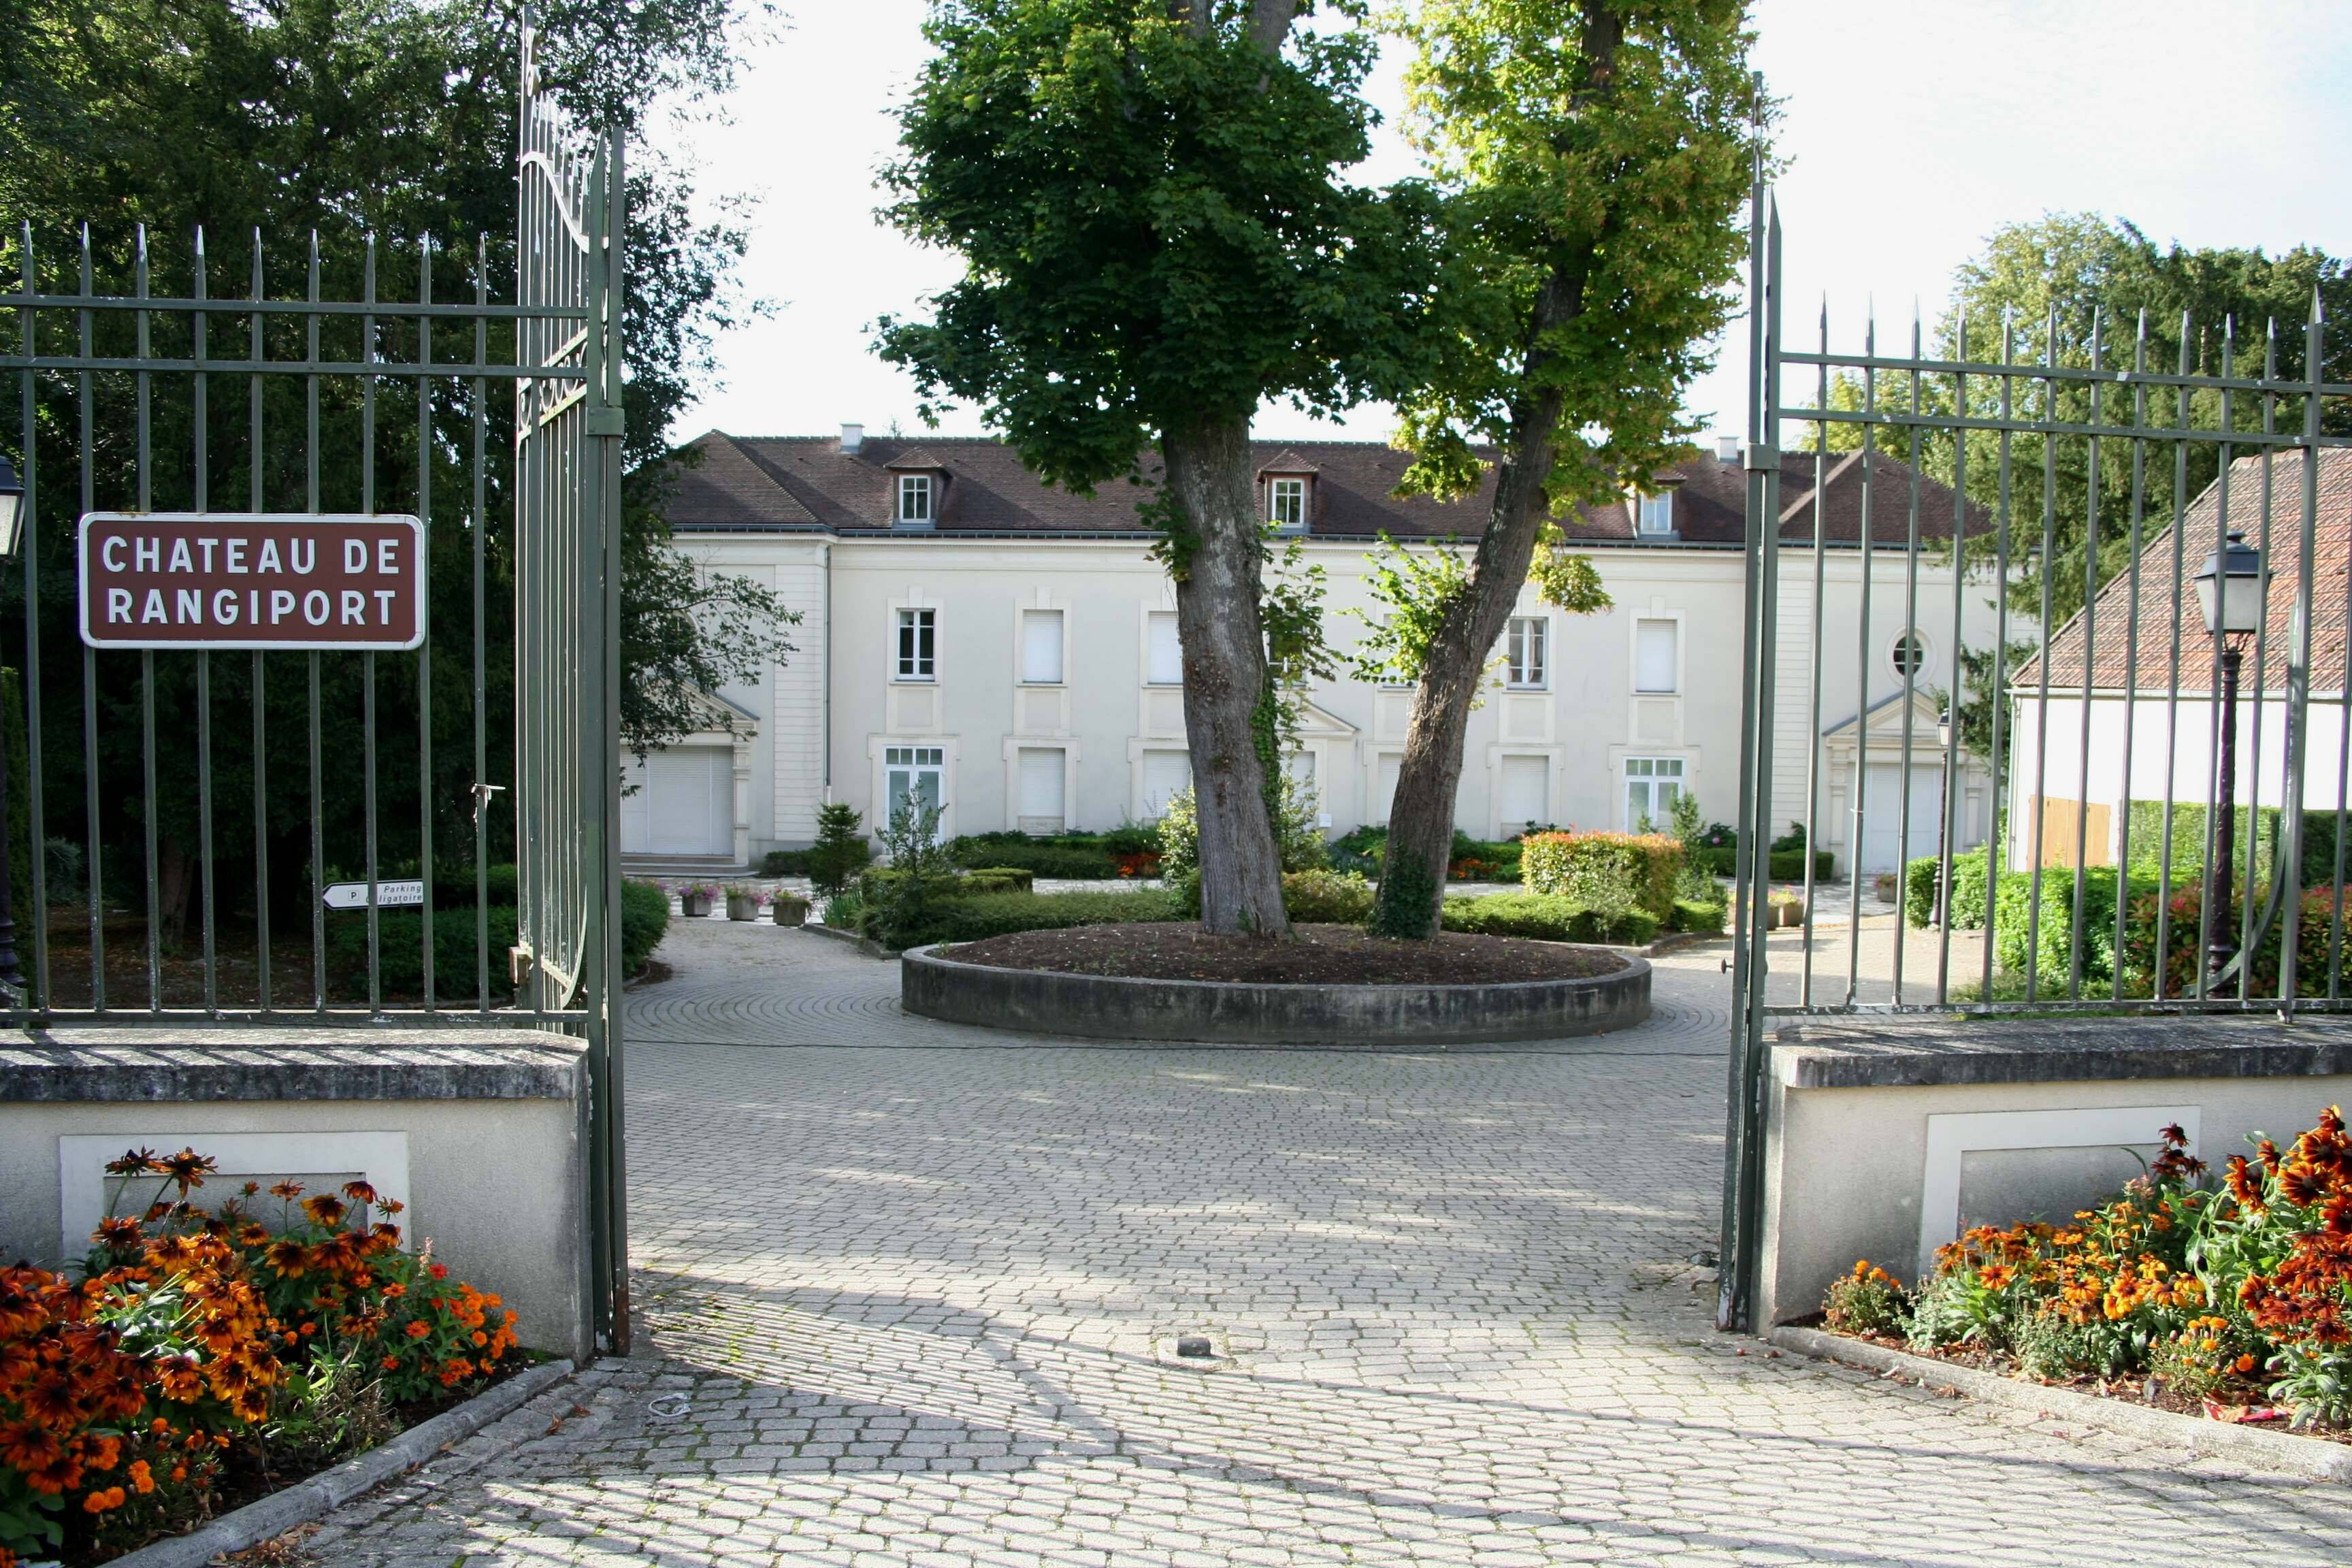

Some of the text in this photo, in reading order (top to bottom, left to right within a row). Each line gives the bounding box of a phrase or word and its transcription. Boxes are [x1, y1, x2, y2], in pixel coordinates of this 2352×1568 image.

[103, 536, 399, 574] CHATEAU DE
[108, 588, 396, 626] RANGIPORT
[384, 885, 422, 894] Parking
